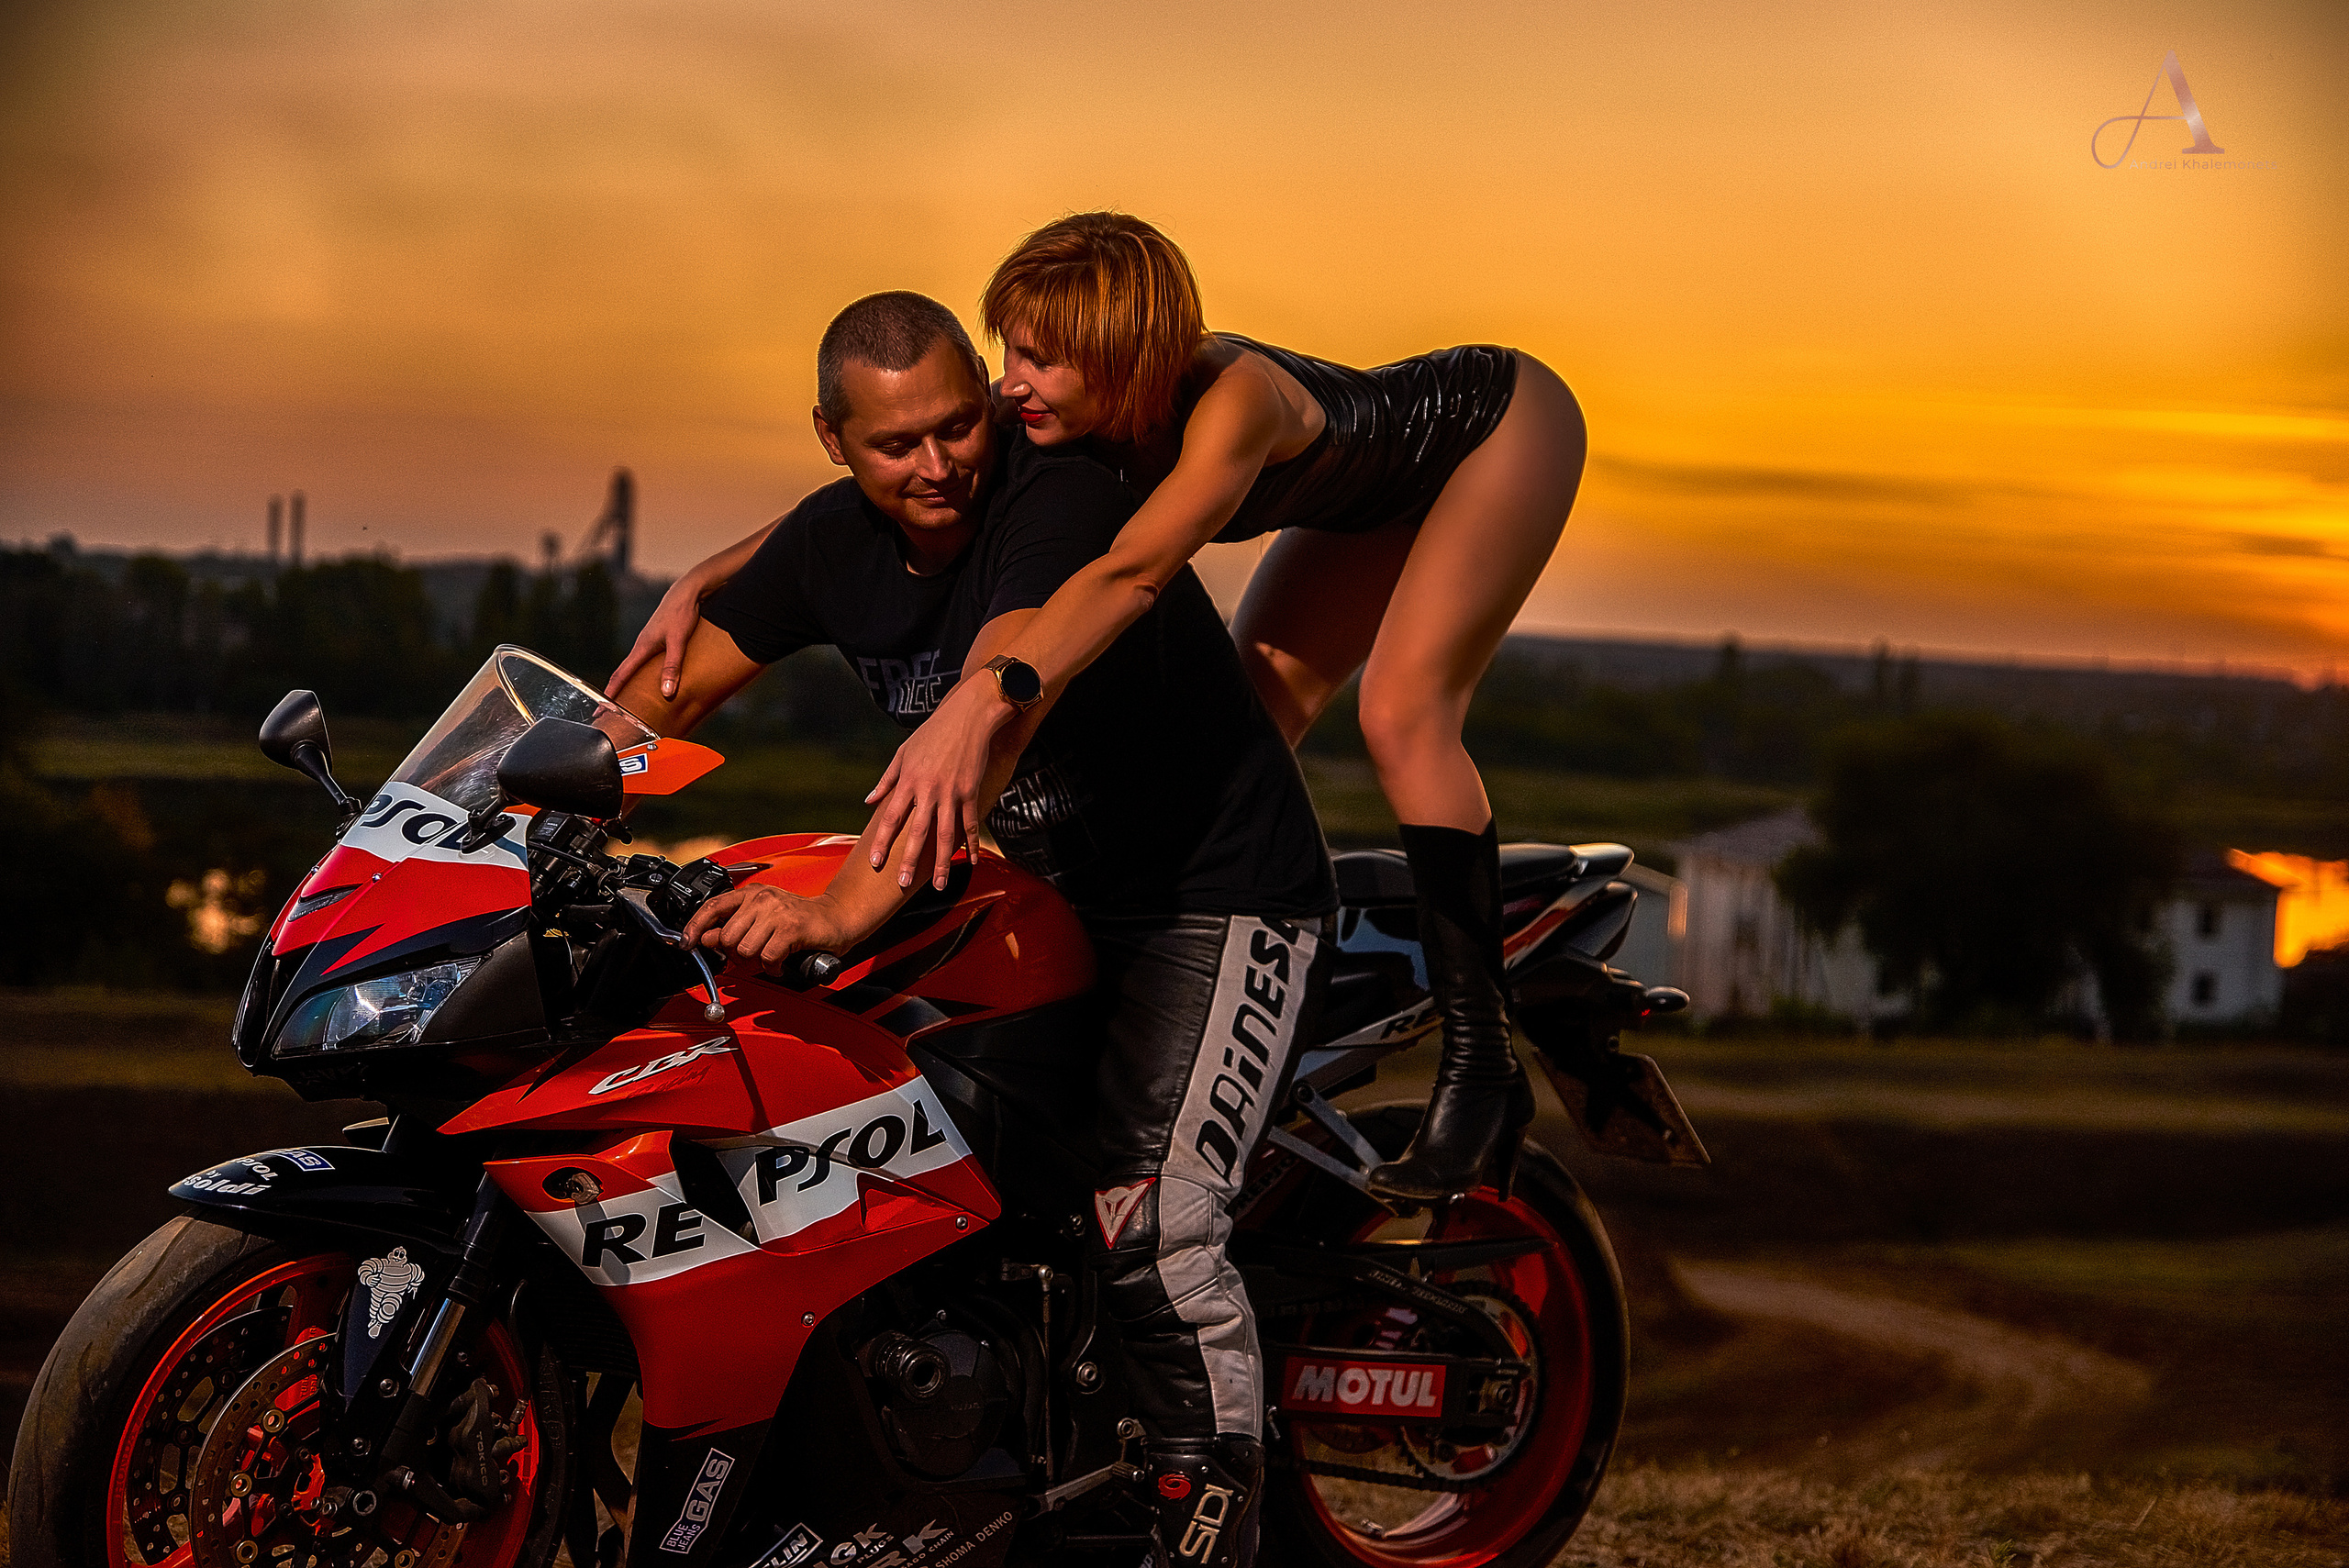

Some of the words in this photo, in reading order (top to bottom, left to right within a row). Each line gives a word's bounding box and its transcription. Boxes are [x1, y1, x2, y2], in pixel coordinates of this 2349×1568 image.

[587, 1036, 737, 1095] CBR
[1292, 1365, 1436, 1407] MOTUL
[476, 1430, 488, 1486] TOKICO
[685, 1458, 729, 1522] GAS
[666, 1523, 689, 1548] BLUE
[677, 1523, 701, 1551] JEANS
[927, 1529, 955, 1553] CHAIN
[974, 1510, 1014, 1542] DENKO
[1178, 1483, 1234, 1564] SIDI
[856, 1534, 895, 1563] PLUGS
